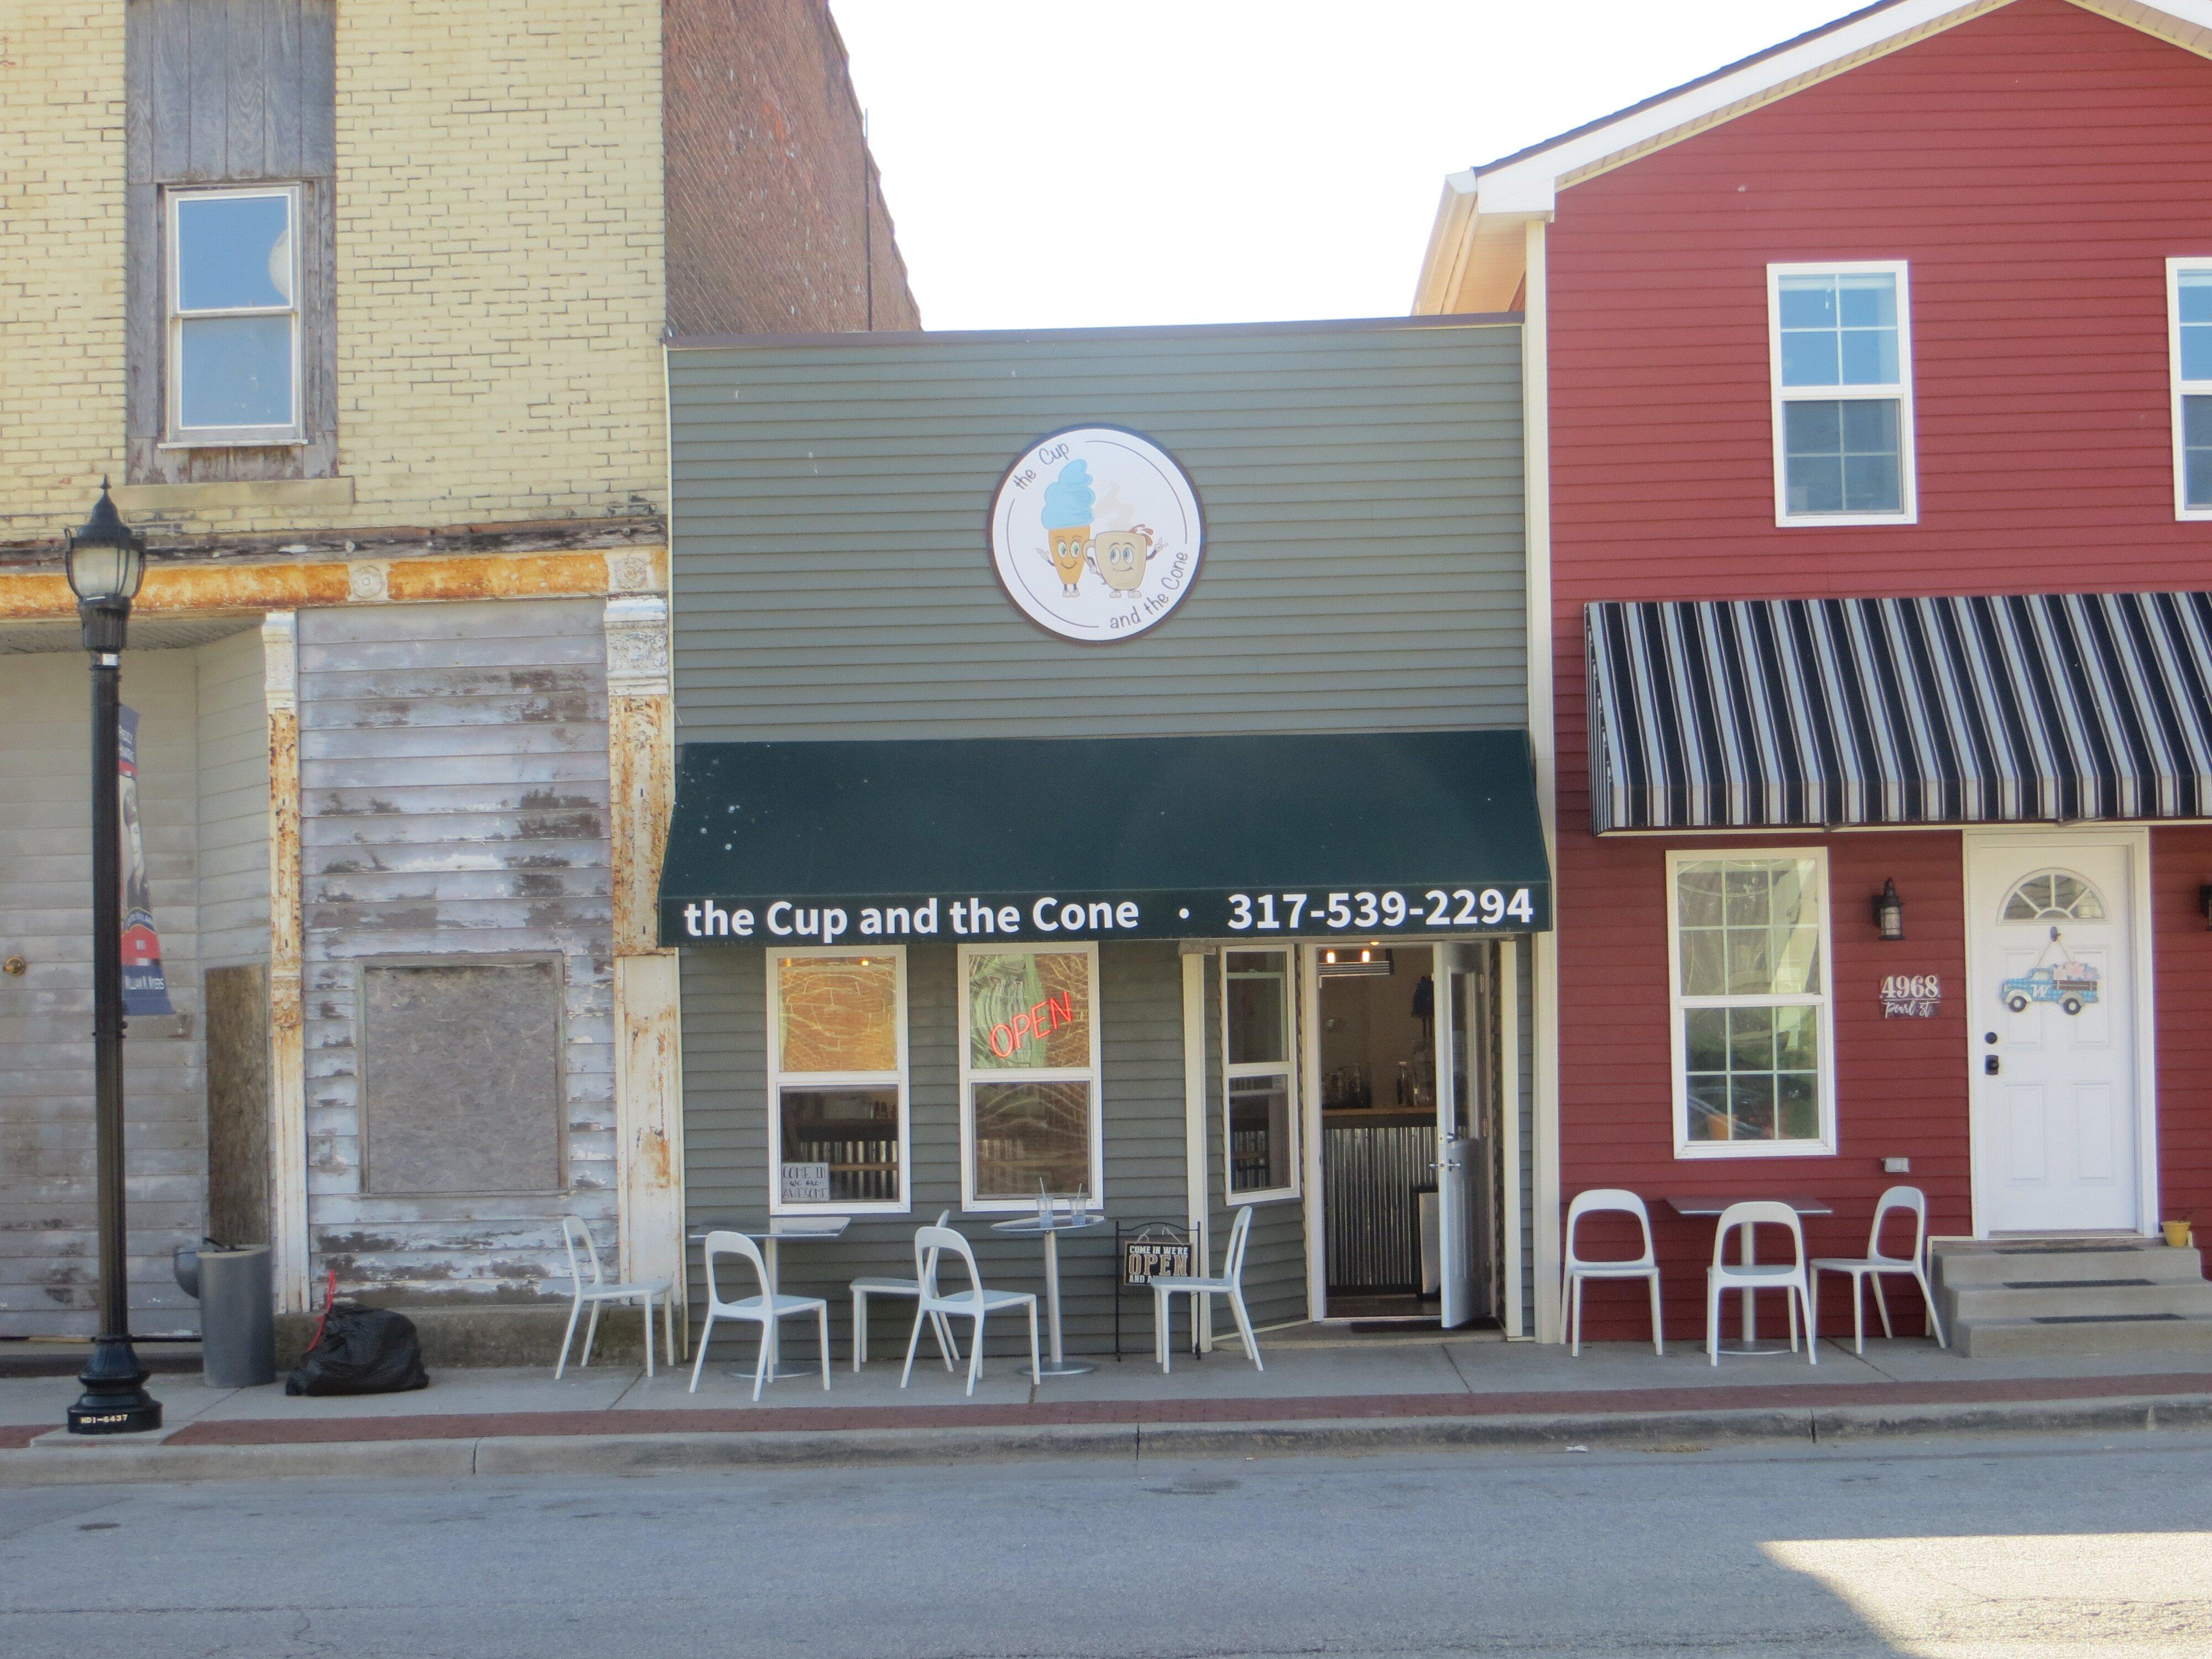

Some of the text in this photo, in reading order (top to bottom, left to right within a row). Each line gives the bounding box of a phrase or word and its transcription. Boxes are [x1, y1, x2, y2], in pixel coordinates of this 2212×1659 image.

[1013, 442, 1070, 491] the Cup
[1109, 551, 1188, 629] and the Cone
[684, 888, 1533, 943] the Cup and the Cone 317-539-2294
[1881, 975, 1938, 998] 4968
[990, 990, 1073, 1059] OPEN
[1129, 1245, 1151, 1254] COME
[1152, 1246, 1161, 1254] IN
[1129, 1254, 1188, 1276] OPEN
[1129, 1275, 1145, 1283] AND
